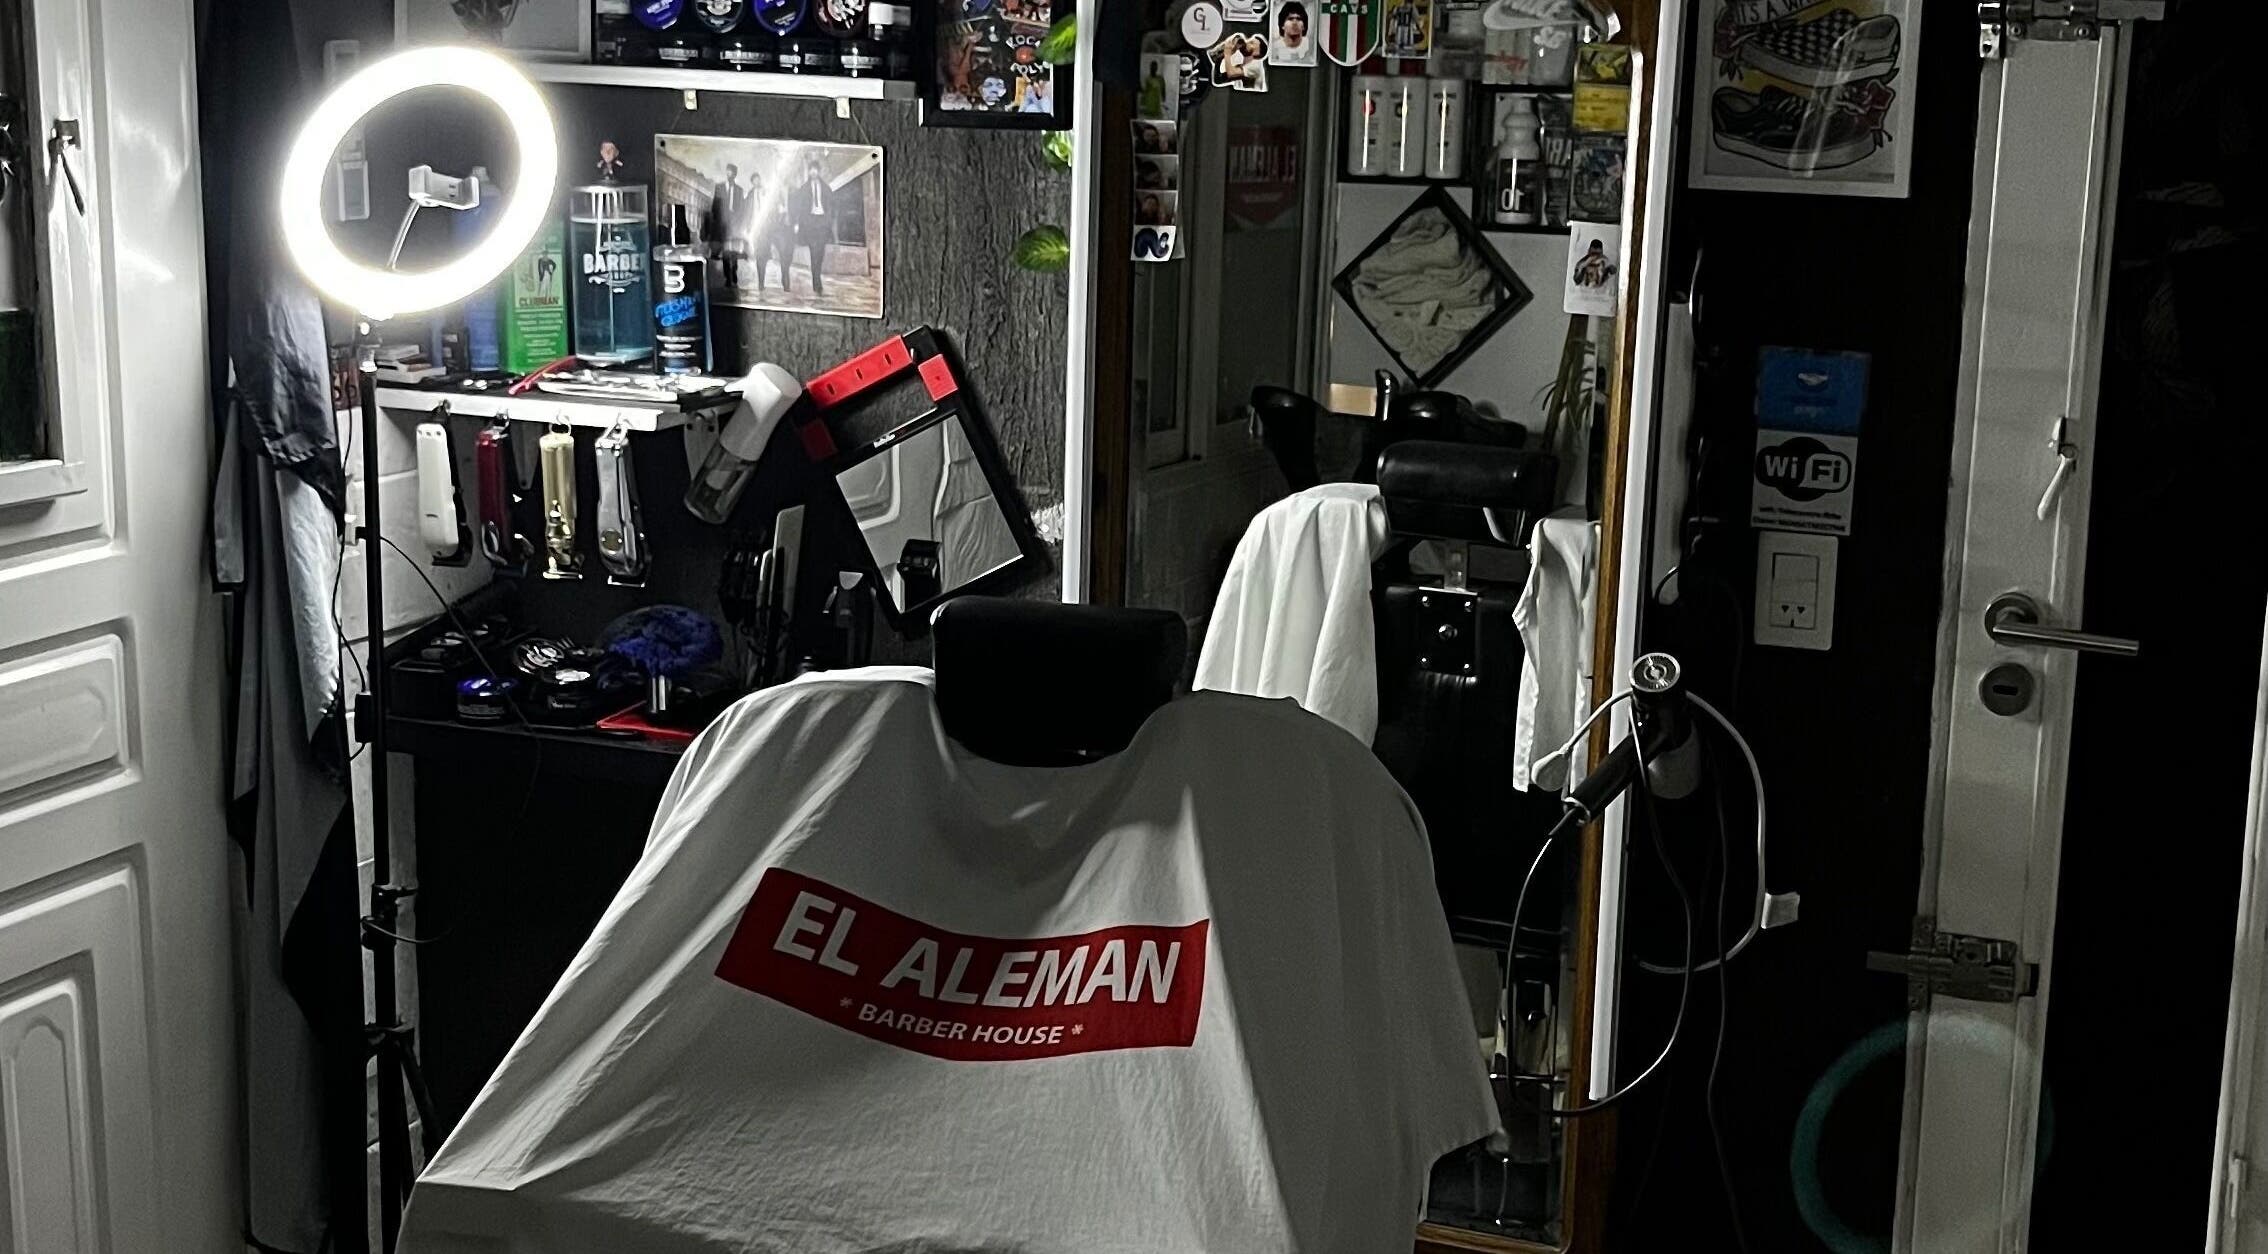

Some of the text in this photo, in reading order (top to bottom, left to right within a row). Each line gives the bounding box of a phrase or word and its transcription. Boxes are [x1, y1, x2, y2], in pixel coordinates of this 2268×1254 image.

[663, 265, 685, 293] B
[772, 890, 1182, 1009] EL ALEMAN
[858, 1002, 1065, 1046] BARBER HOUSE
